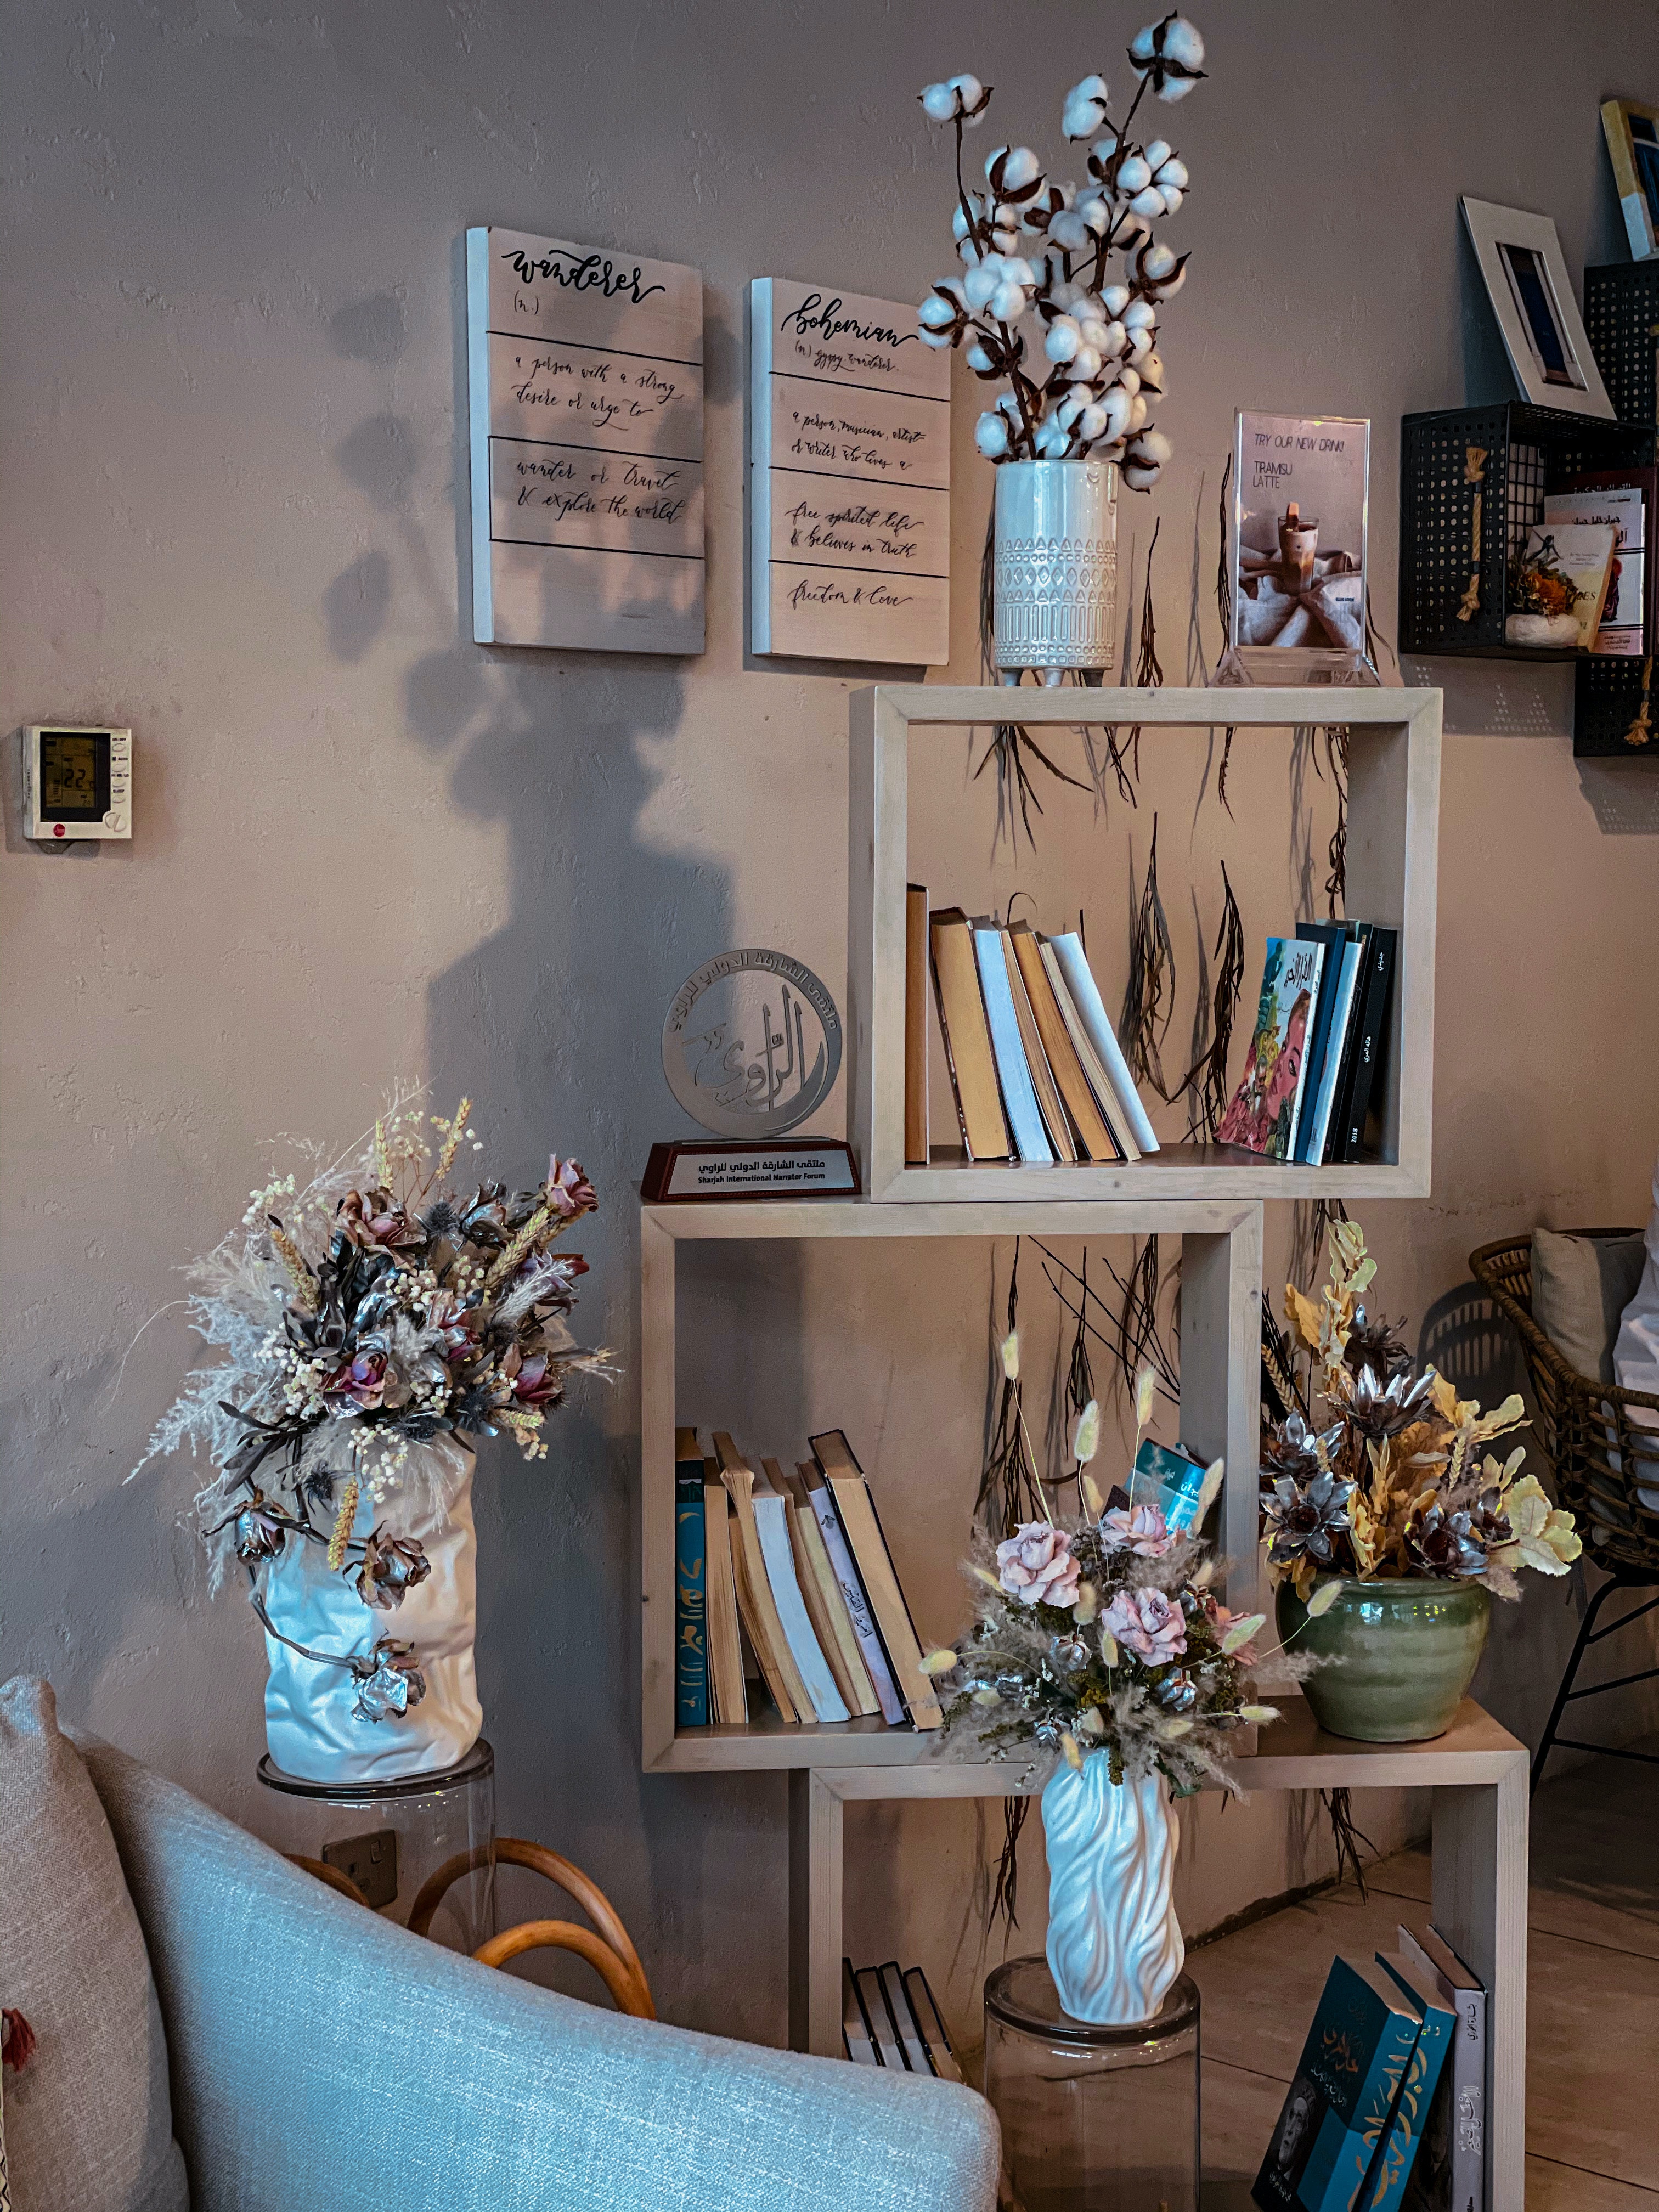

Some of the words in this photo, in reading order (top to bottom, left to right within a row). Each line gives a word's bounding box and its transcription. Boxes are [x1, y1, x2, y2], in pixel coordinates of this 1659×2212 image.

[501, 250, 665, 303] wanderer
[514, 290, 539, 315] (n.)
[781, 294, 919, 347] bohemian
[515, 357, 521, 367] a
[532, 356, 573, 379] person
[581, 364, 612, 382] with
[620, 374, 627, 383] a
[636, 369, 684, 404] strong
[511, 381, 560, 405] desire
[568, 392, 585, 410] or
[590, 398, 628, 431] urge
[622, 399, 653, 417] to
[793, 412, 800, 422] a
[893, 428, 927, 443] artist
[1255, 433, 1272, 447] TRY
[1274, 436, 1293, 448] OUR
[1296, 438, 1317, 450] NEW
[792, 439, 803, 454] or
[805, 441, 836, 459] writer
[842, 445, 861, 462] who
[861, 452, 892, 469] lives
[900, 460, 913, 471] a
[517, 459, 576, 481] wander
[591, 466, 609, 484] or
[622, 461, 681, 490] travel
[1252, 475, 1280, 489] LATTE
[517, 486, 538, 506] &
[541, 491, 596, 521] explore
[601, 495, 628, 517] the
[635, 498, 686, 524] world
[785, 501, 821, 524] free
[825, 506, 881, 528] spirited
[879, 511, 924, 537] life
[791, 528, 803, 545] &
[804, 525, 855, 551] believes
[862, 543, 874, 552] in
[877, 539, 917, 558] truth
[787, 579, 850, 610] freedom
[854, 588, 866, 605] &
[864, 586, 913, 606] love
[64, 769, 86, 788] 22
[699, 952, 749, 985] الدولي
[754, 951, 809, 984] الشارقة
[668, 981, 698, 1032] للراوي
[808, 983, 838, 1029] ملتقى
[698, 1163, 727, 1173] للراوي
[698, 1176, 725, 1184] Sharjah
[726, 1174, 771, 1183] International
[730, 1161, 759, 1173] الدولي
[762, 1159, 794, 1171] الشارقة
[797, 1159, 825, 1169] ملتقى
